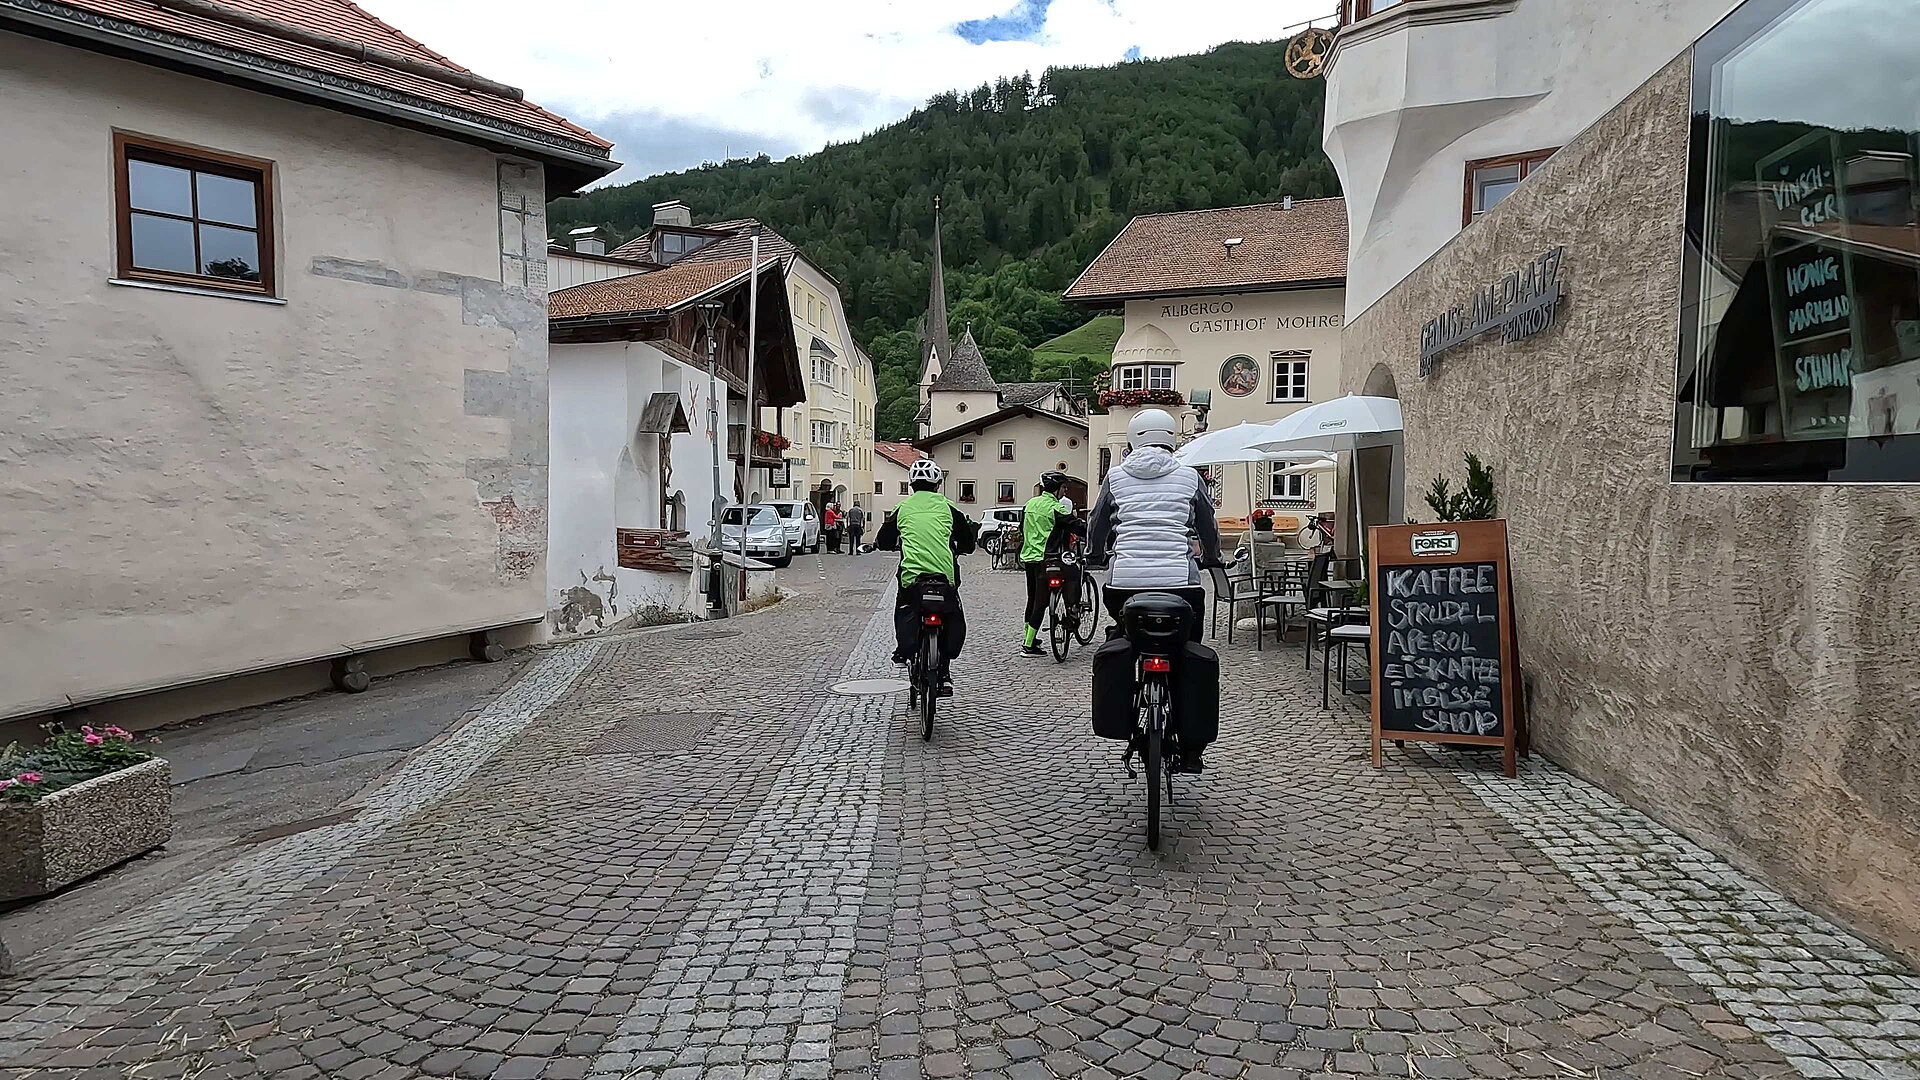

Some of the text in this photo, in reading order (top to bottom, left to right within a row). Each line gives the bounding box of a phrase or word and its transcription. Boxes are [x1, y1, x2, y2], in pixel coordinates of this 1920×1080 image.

[1800, 194, 1843, 228] GER
[1470, 284, 1496, 330] AM
[1502, 246, 1564, 314] PLATZ
[1160, 301, 1234, 318] ALBERGO
[1189, 314, 1345, 334] GASTHOF MOHRE
[1500, 299, 1559, 347] FEINKOST
[1414, 537, 1456, 550] FORST
[1386, 565, 1496, 598] KAFFEE
[1387, 598, 1496, 630] STRUDEL
[1387, 628, 1478, 655] APEROL
[1414, 709, 1499, 736] SHOP
